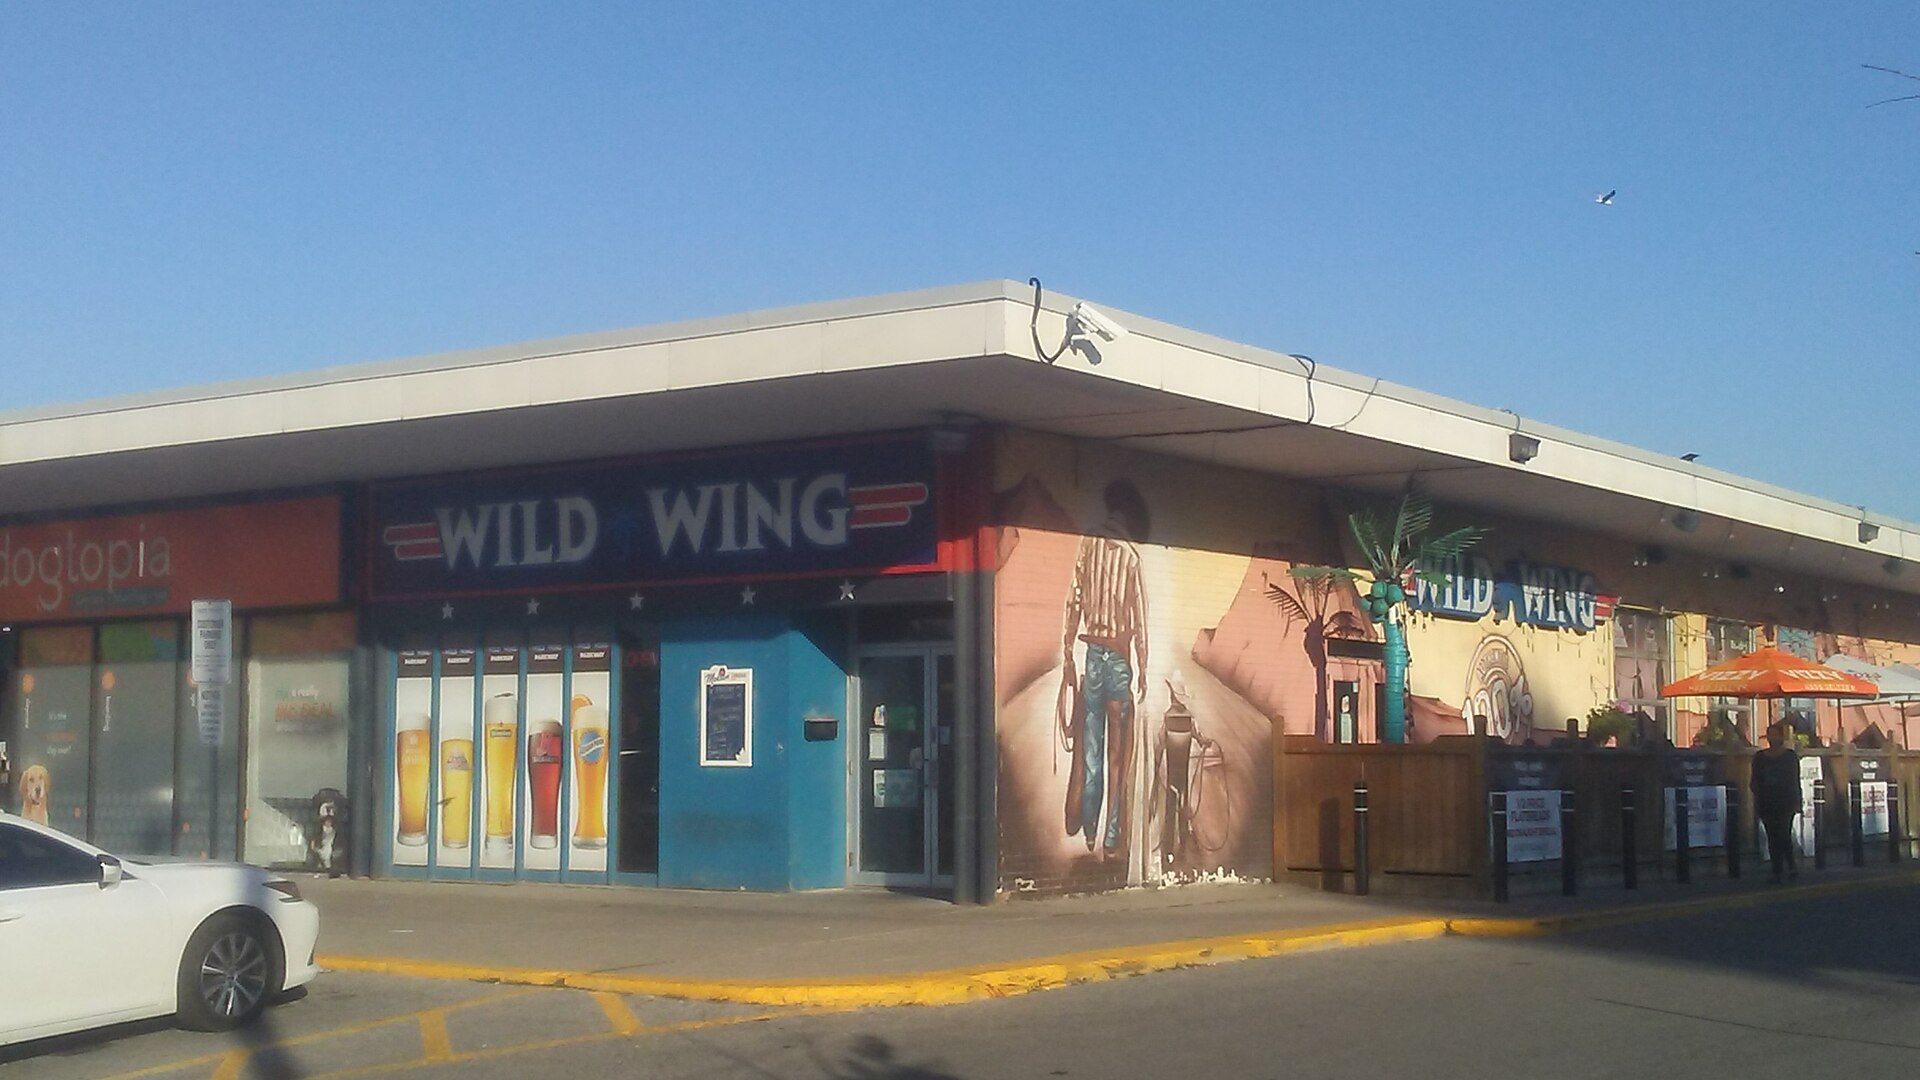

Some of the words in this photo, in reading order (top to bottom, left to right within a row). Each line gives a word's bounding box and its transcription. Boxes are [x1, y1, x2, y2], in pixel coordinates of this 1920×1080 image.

[436, 496, 599, 570] WILD
[647, 473, 852, 556] WING
[0, 522, 171, 610] dogtopia
[1414, 556, 1495, 614] WILD
[1519, 561, 1595, 629] WING
[1699, 669, 1768, 681] VIZZY
[1778, 669, 1844, 681] VIZZY
